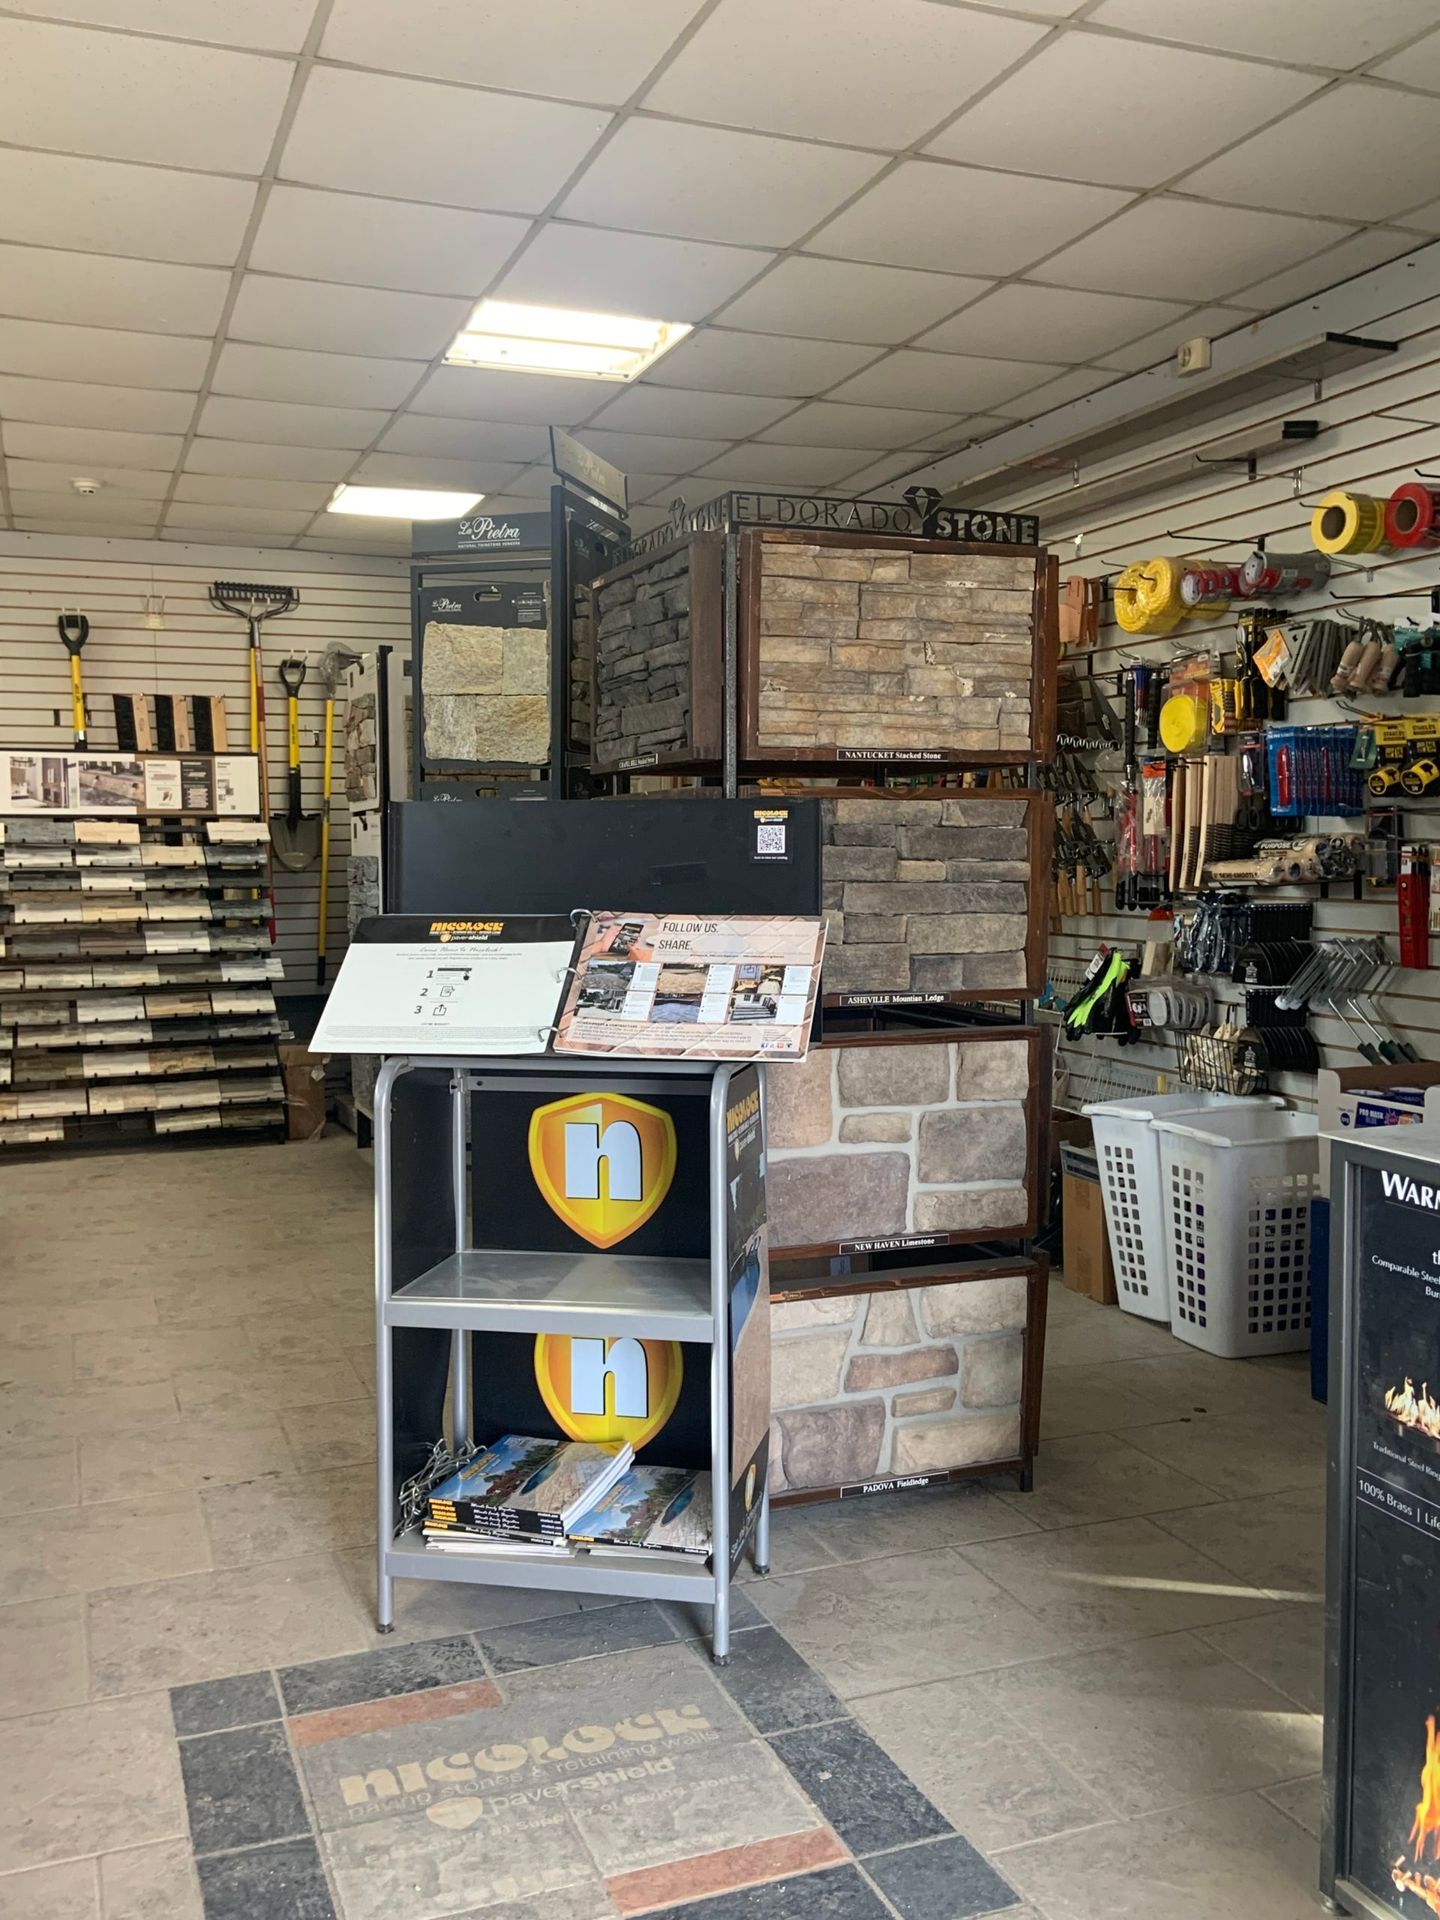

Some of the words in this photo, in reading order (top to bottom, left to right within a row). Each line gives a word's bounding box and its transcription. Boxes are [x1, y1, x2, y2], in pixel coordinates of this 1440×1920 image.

[736, 497, 912, 532] ELDORADO
[936, 510, 1036, 544] STONE
[458, 521, 472, 535] La
[471, 516, 520, 540] Pietra
[845, 751, 894, 759] NANTUCKET
[895, 751, 921, 759] Stacked
[922, 752, 942, 760] Stone
[430, 922, 504, 931] NICOLOCK
[662, 922, 702, 933] FOLLOW
[704, 923, 719, 933] US.
[658, 939, 693, 950] SHARE.
[426, 970, 434, 979] 1
[420, 988, 428, 997] 2
[847, 995, 890, 1004] ASHEVILLE
[925, 994, 944, 1003] Ledge
[414, 1005, 423, 1015] 3
[1359, 1108, 1369, 1117] PRO
[854, 1243, 874, 1251] NEW
[874, 1240, 900, 1250] HAVEN
[901, 1238, 935, 1248] Limestone
[1371, 1255, 1420, 1278] Comparable
[863, 1482, 894, 1493] PADOVA
[896, 1477, 929, 1488] Fieldledge
[1359, 1480, 1385, 1502] 100%
[1386, 1493, 1413, 1516] Brass
[348, 1791, 431, 1820] paving
[440, 1774, 523, 1798] stones
[531, 1765, 547, 1778] &
[556, 1742, 657, 1773] retaining
[661, 1728, 721, 1750] walls
